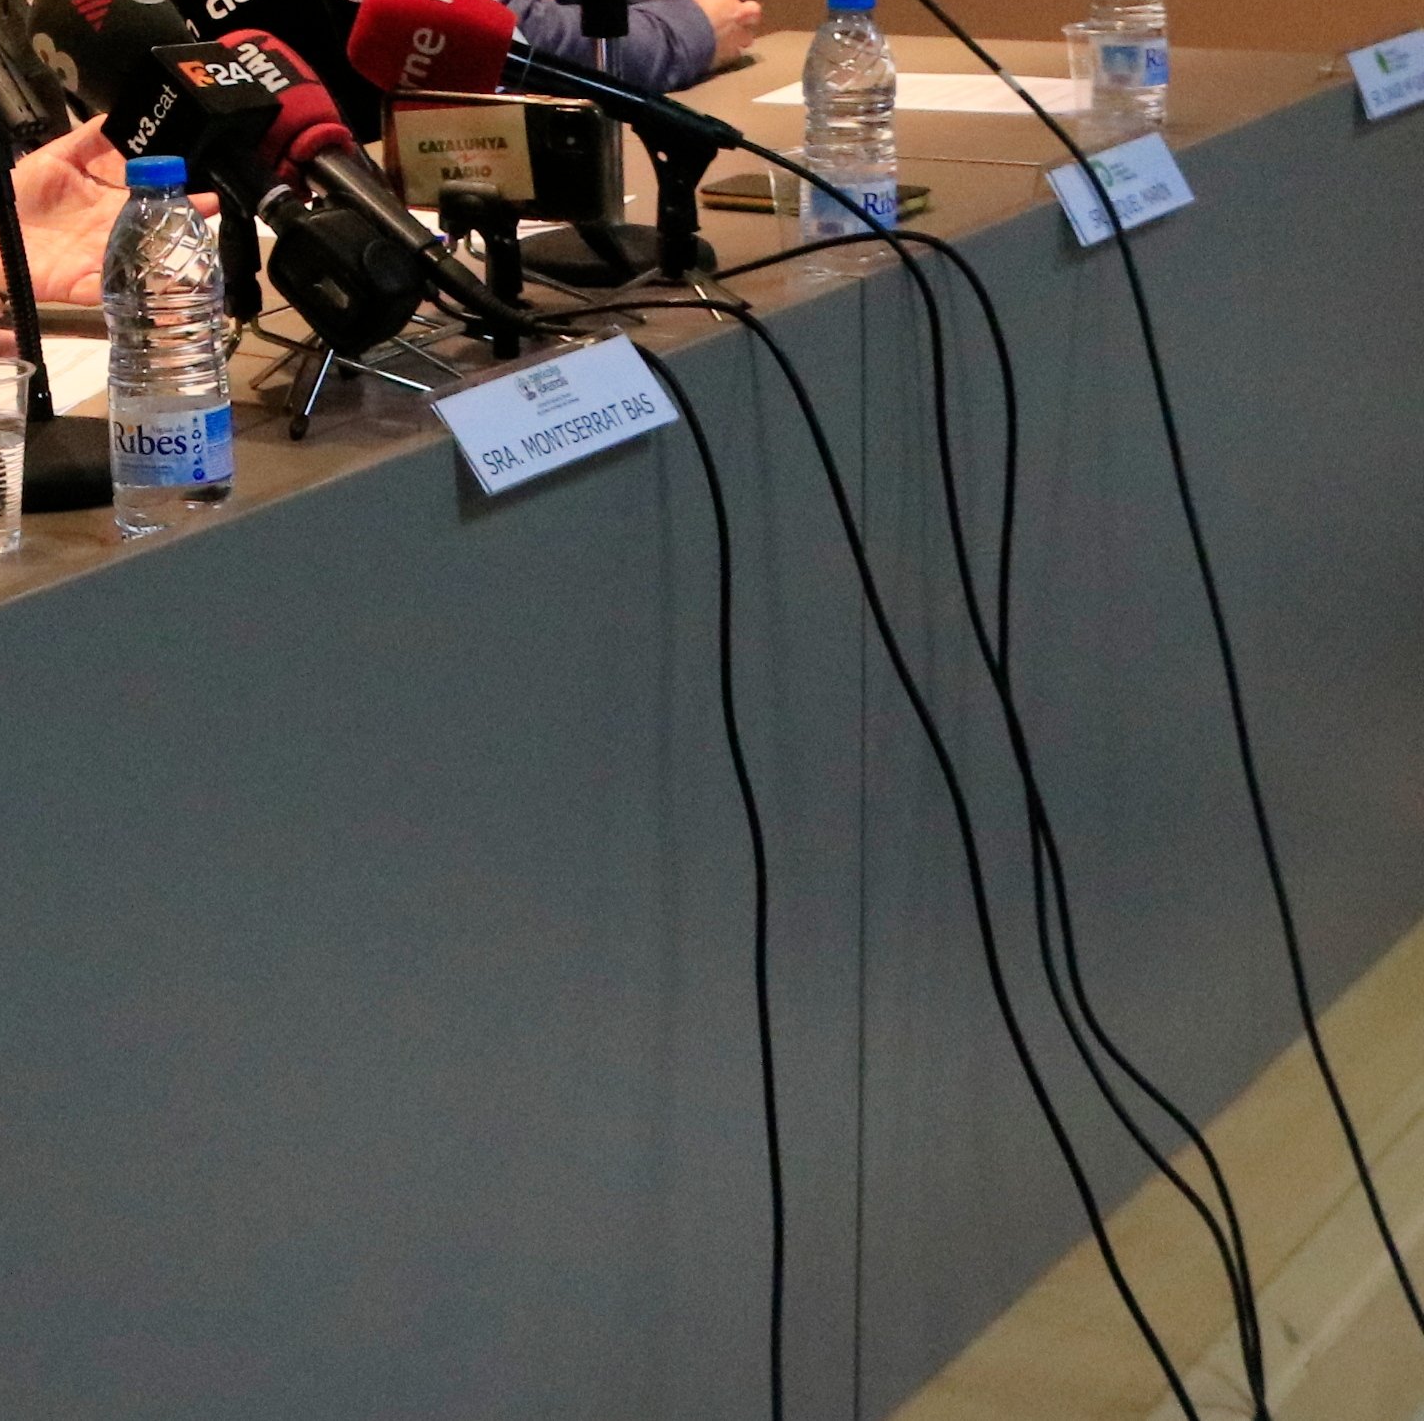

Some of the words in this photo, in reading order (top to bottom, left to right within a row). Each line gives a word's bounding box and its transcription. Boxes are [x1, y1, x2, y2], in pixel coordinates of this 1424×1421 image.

[127, 83, 178, 155] tv3.cat
[418, 137, 508, 154] CATALUNYA
[112, 421, 187, 455] Ribes
[482, 445, 525, 476] SRA.
[521, 404, 625, 459] MONTSERRAT
[622, 393, 655, 420] BAS
